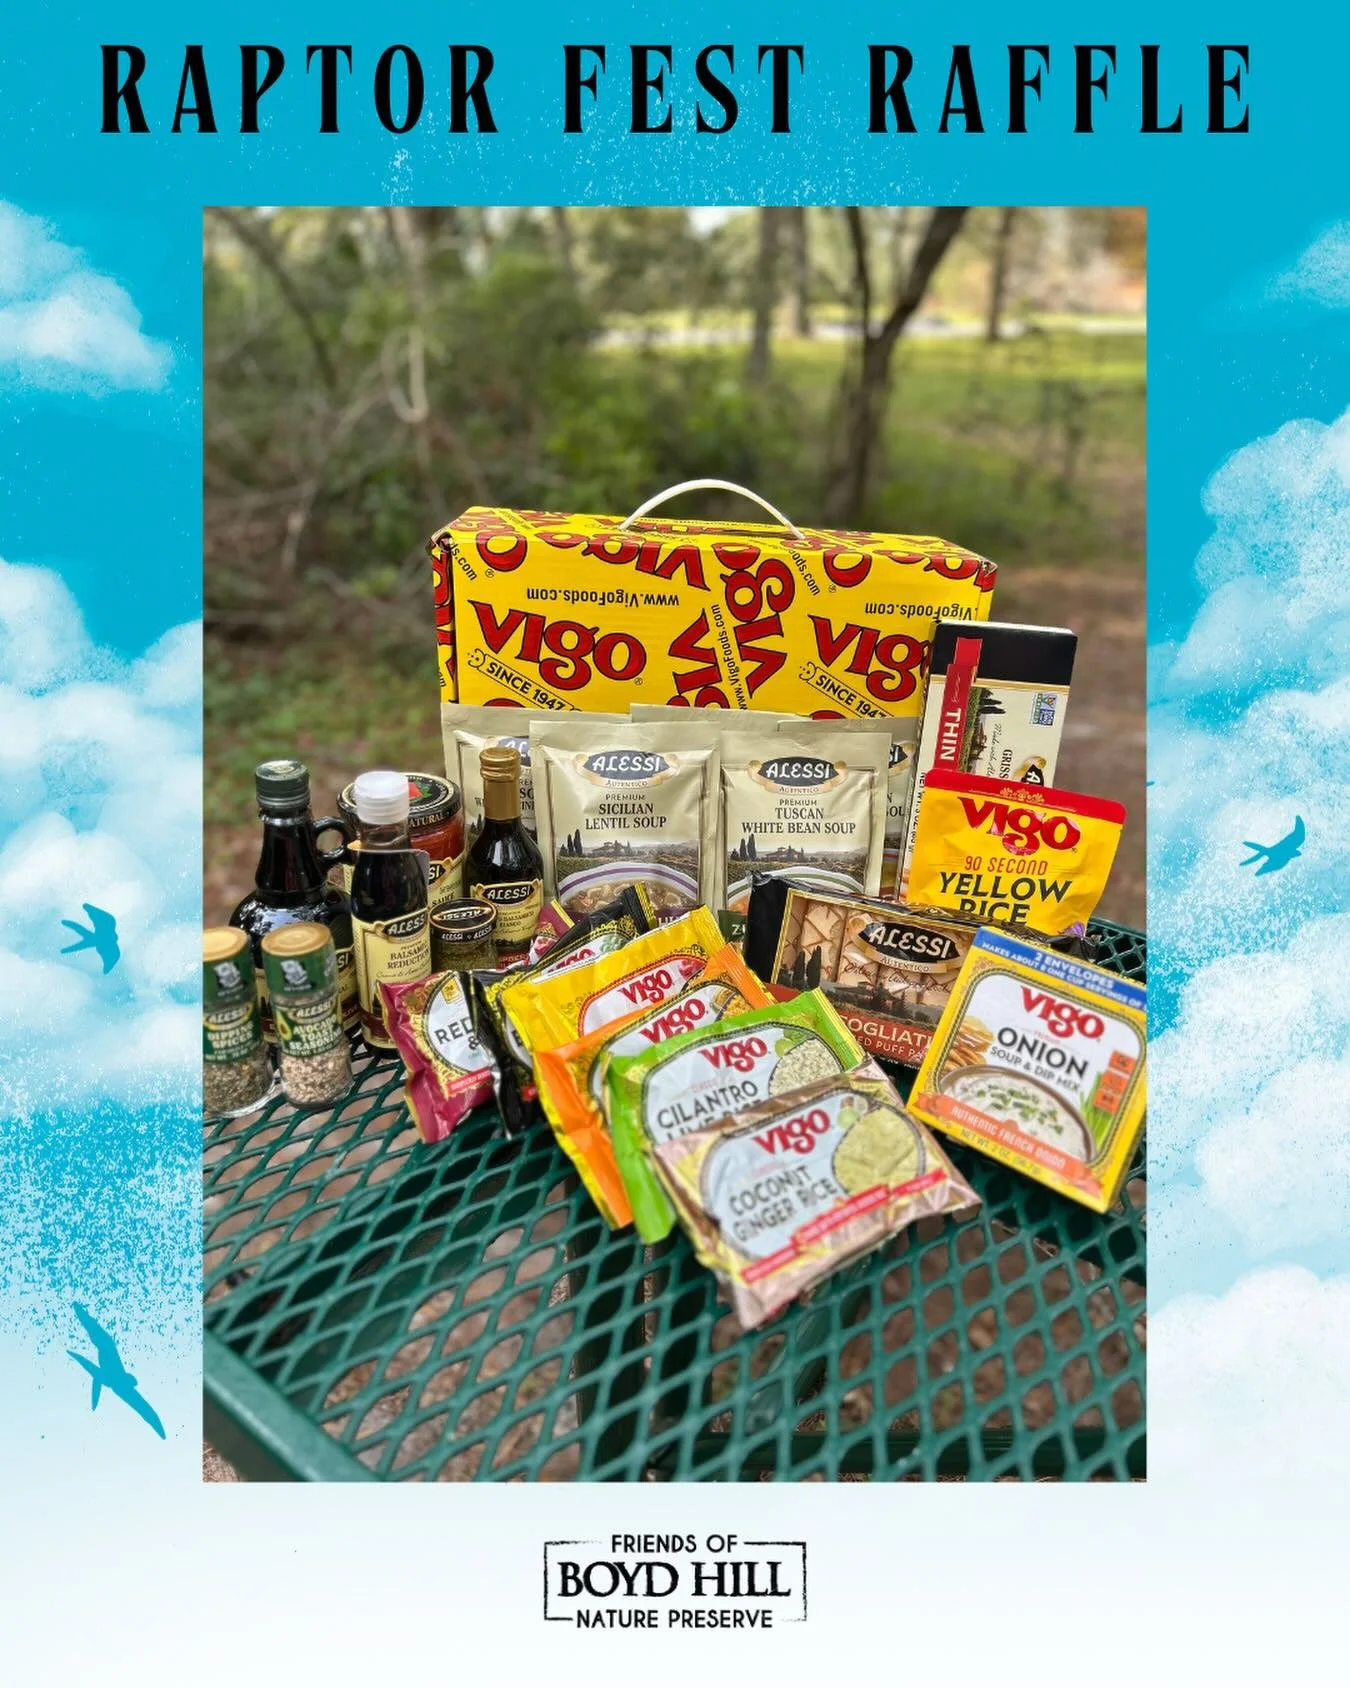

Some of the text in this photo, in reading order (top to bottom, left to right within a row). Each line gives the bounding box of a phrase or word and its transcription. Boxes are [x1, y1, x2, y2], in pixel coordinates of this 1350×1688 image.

[526, 587, 680, 608] www.VigoFoods.com
[486, 661, 531, 695] SINCE
[815, 674, 855, 707] SINCE
[941, 708, 962, 761] THIN
[591, 755, 661, 772] ALESSI
[765, 762, 831, 779] ALESSI
[605, 793, 646, 801] PREMIUM
[779, 799, 818, 807] PREMIUM
[407, 811, 446, 828] ATURAL
[598, 803, 654, 815] SICILIAN
[774, 807, 825, 820] TUSCAN
[585, 816, 667, 830] LENTIL SOUP
[741, 822, 856, 834] WHITE BEAN SOUP
[964, 856, 1049, 876] 90 SECOND
[487, 885, 531, 900] ALESSI
[939, 871, 1073, 904] YELLOW
[867, 924, 951, 959] ALESSI
[981, 942, 1010, 957] MAKES
[1010, 953, 1039, 970] ABOUT
[1035, 952, 1116, 989] 2 ENVELOPES
[875, 1039, 905, 1055] PUFF
[997, 1026, 1089, 1081] ONION
[990, 1045, 1081, 1092] SOUP & DIP MIX
[656, 1080, 759, 1130] CILANTRO
[729, 1164, 812, 1217] COCONUT
[732, 1202, 796, 1243] GINGER
[801, 1177, 838, 1209] RICE
